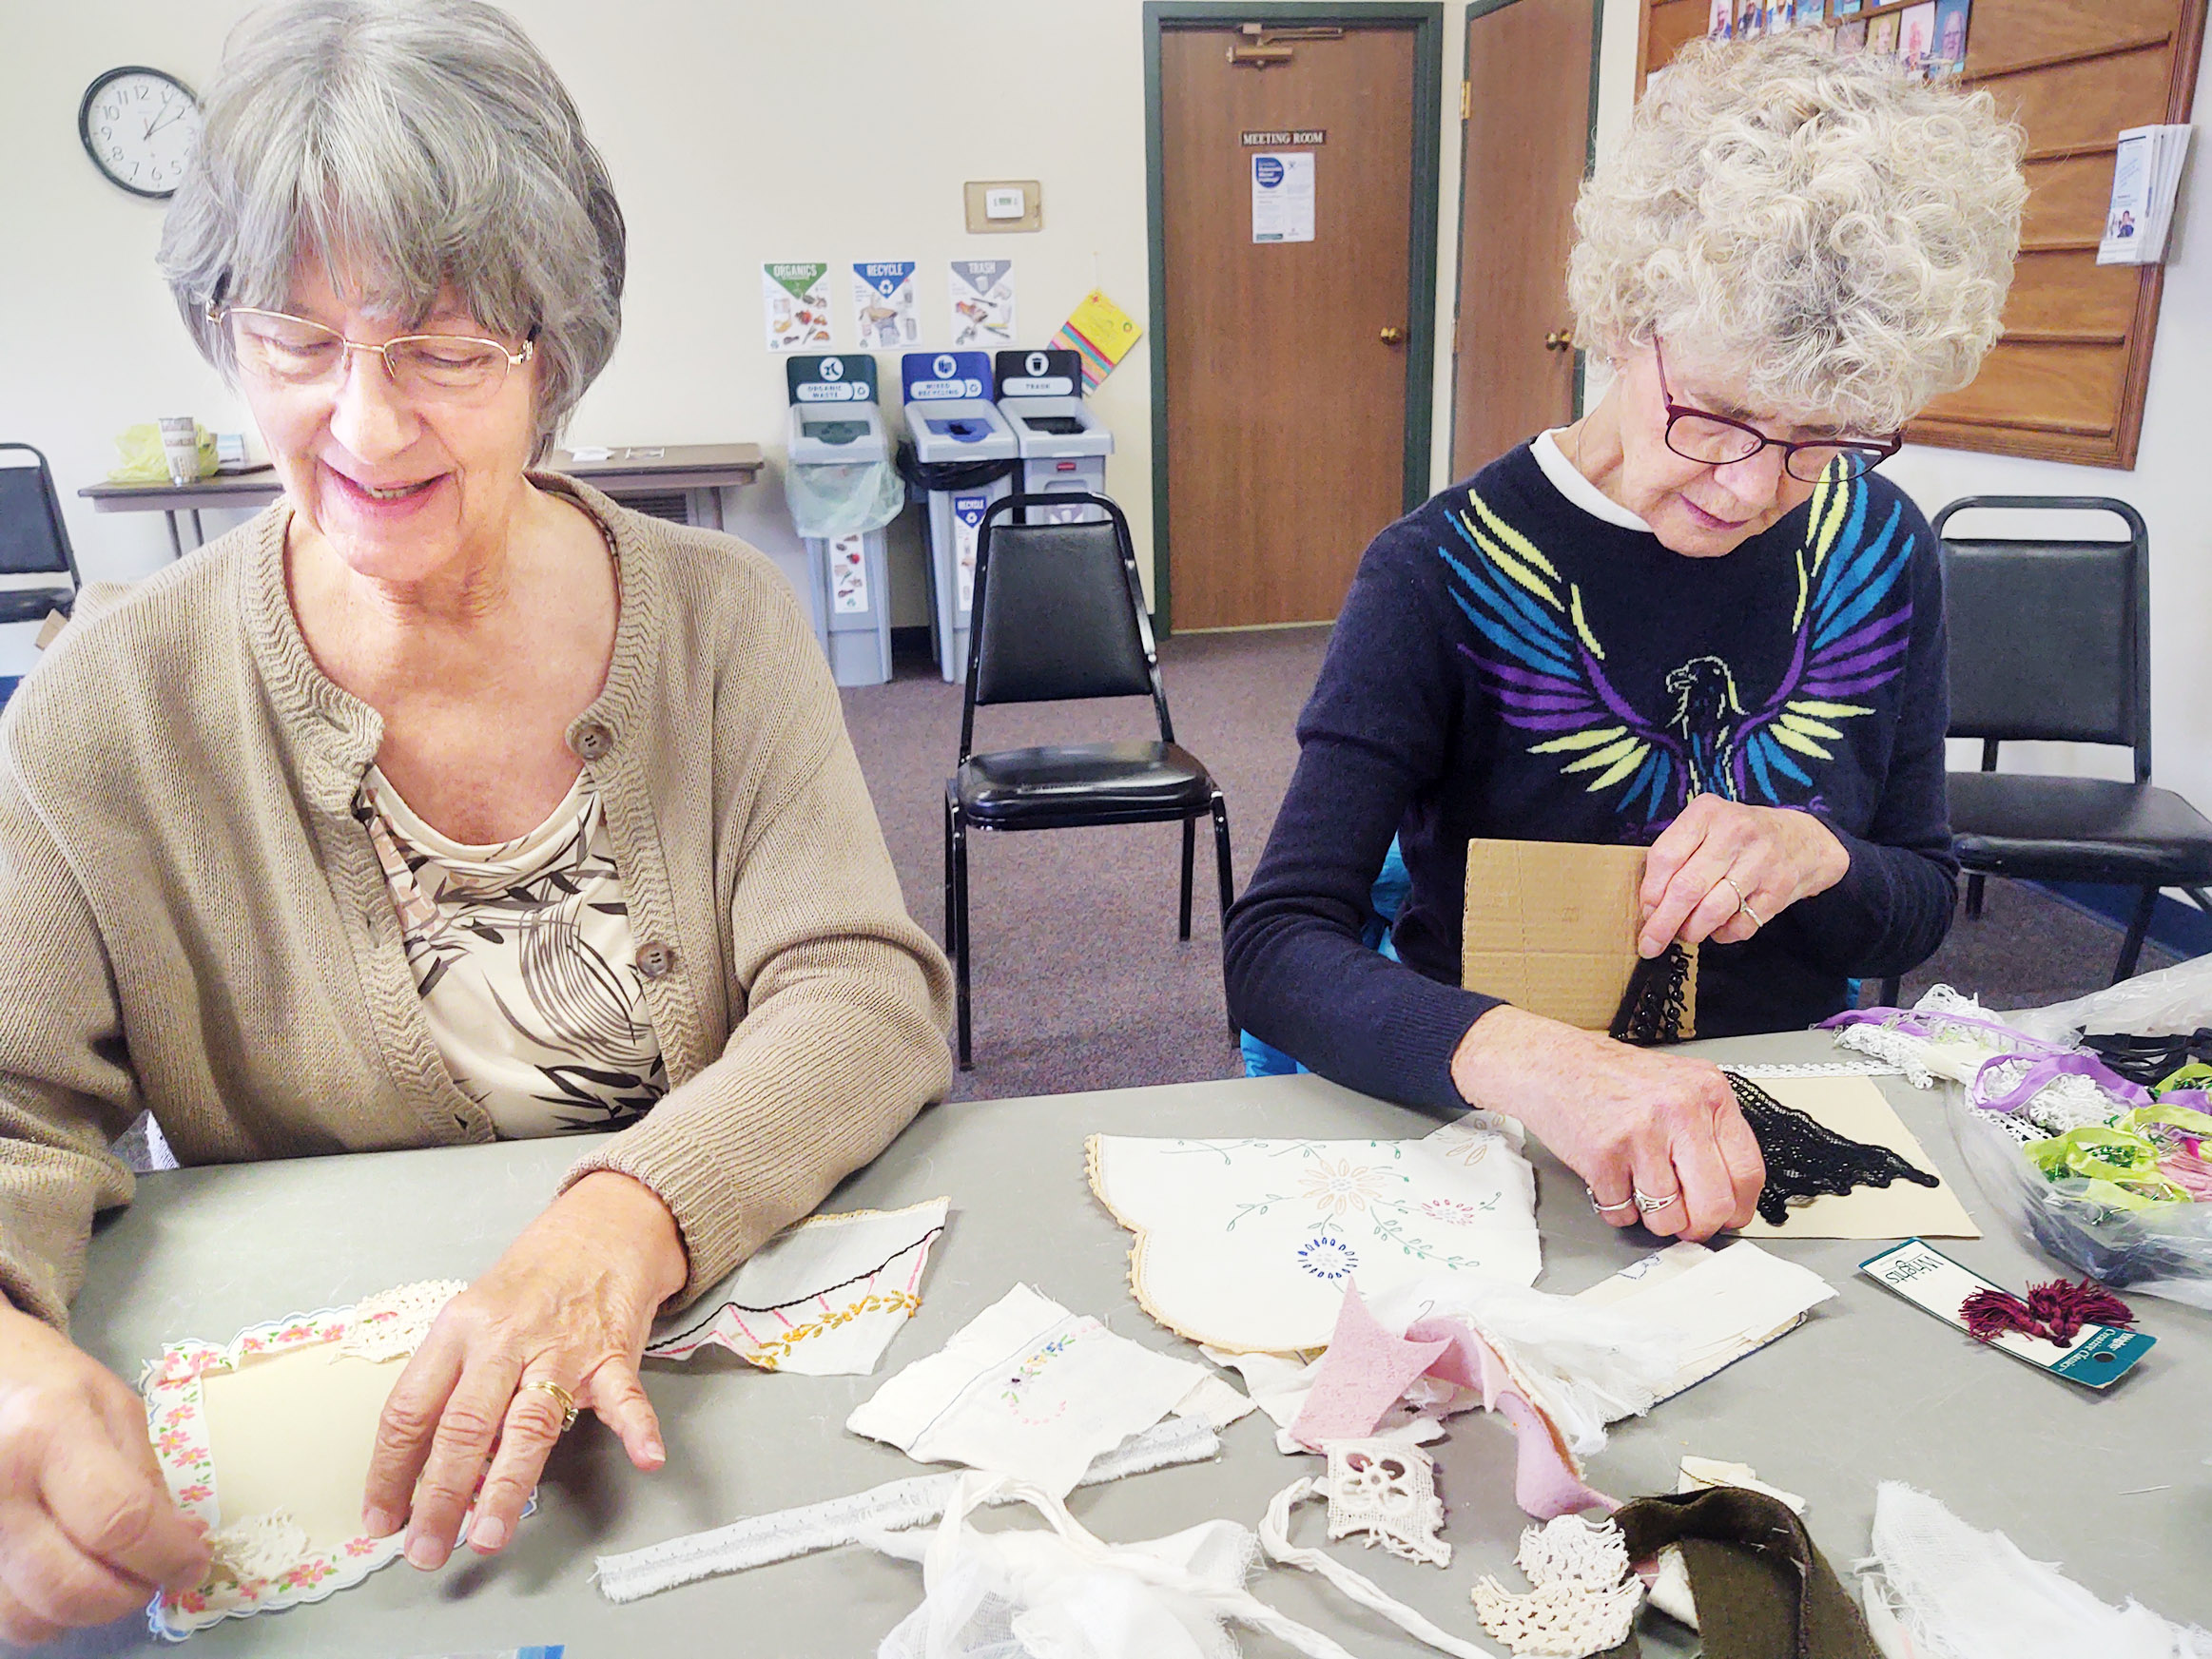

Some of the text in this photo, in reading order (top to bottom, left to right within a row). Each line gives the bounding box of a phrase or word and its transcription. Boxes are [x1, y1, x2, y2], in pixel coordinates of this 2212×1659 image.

[117, 90, 128, 105] 11
[134, 85, 150, 100] 12
[104, 106, 120, 121] 10
[101, 125, 112, 141] 9
[1243, 132, 1323, 145] MEETING ROOM
[112, 145, 124, 161] 8
[152, 166, 163, 181] 6
[773, 264, 817, 277] ORGANICS
[866, 263, 904, 277] RECYCLE
[968, 261, 996, 274] TRASH
[957, 499, 984, 510] RECYCLE
[1885, 1255, 1944, 1283] Wrights
[2085, 1328, 2116, 1351] Creative
